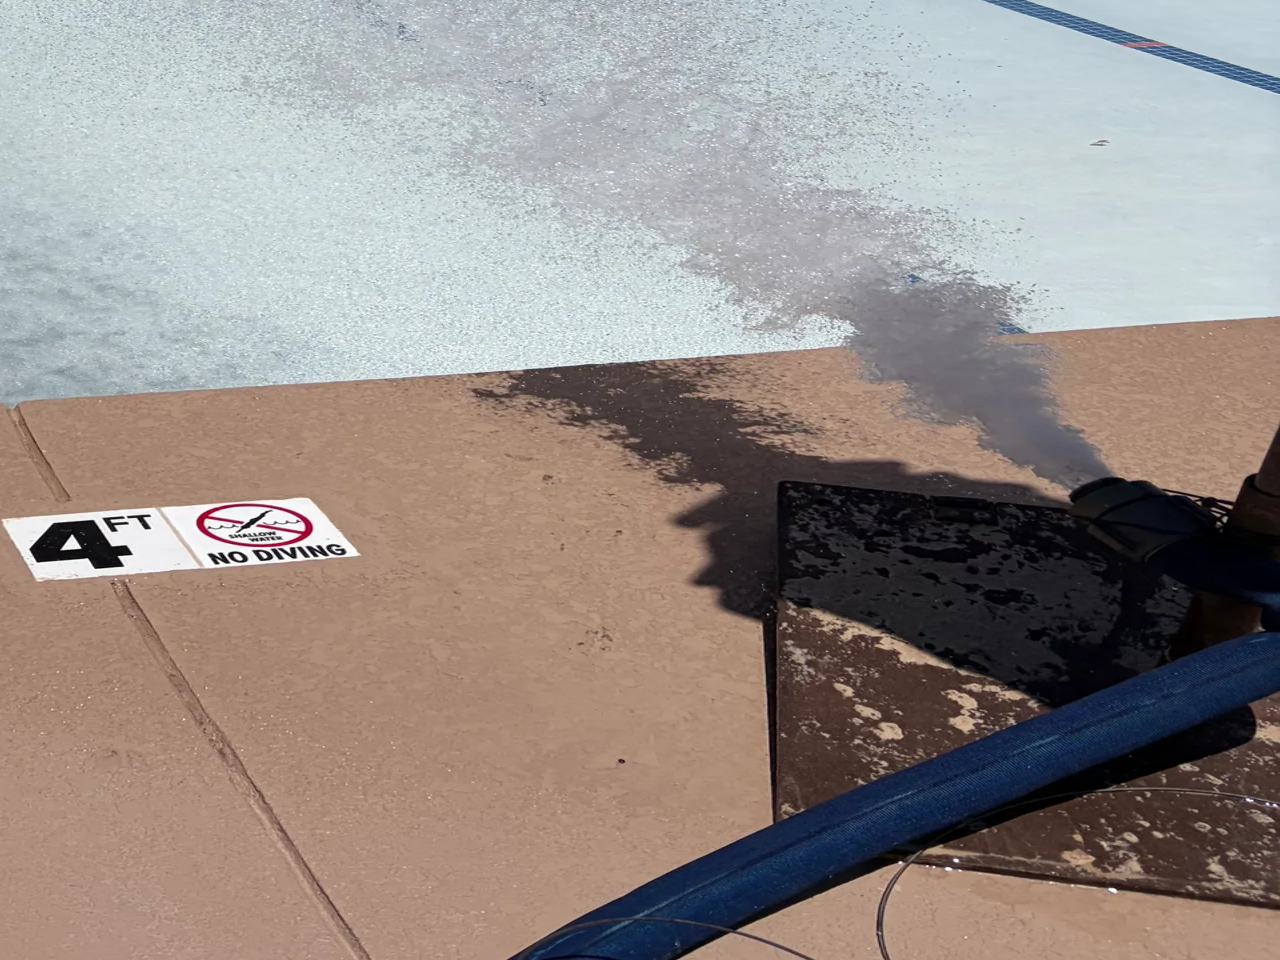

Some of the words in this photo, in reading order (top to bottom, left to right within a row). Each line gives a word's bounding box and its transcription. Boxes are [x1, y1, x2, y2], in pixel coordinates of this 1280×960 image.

[29, 520, 133, 569] 4
[102, 514, 152, 532] FT
[228, 531, 276, 539] SHALLOW
[207, 551, 248, 565] NO
[252, 544, 347, 561] DIVING
